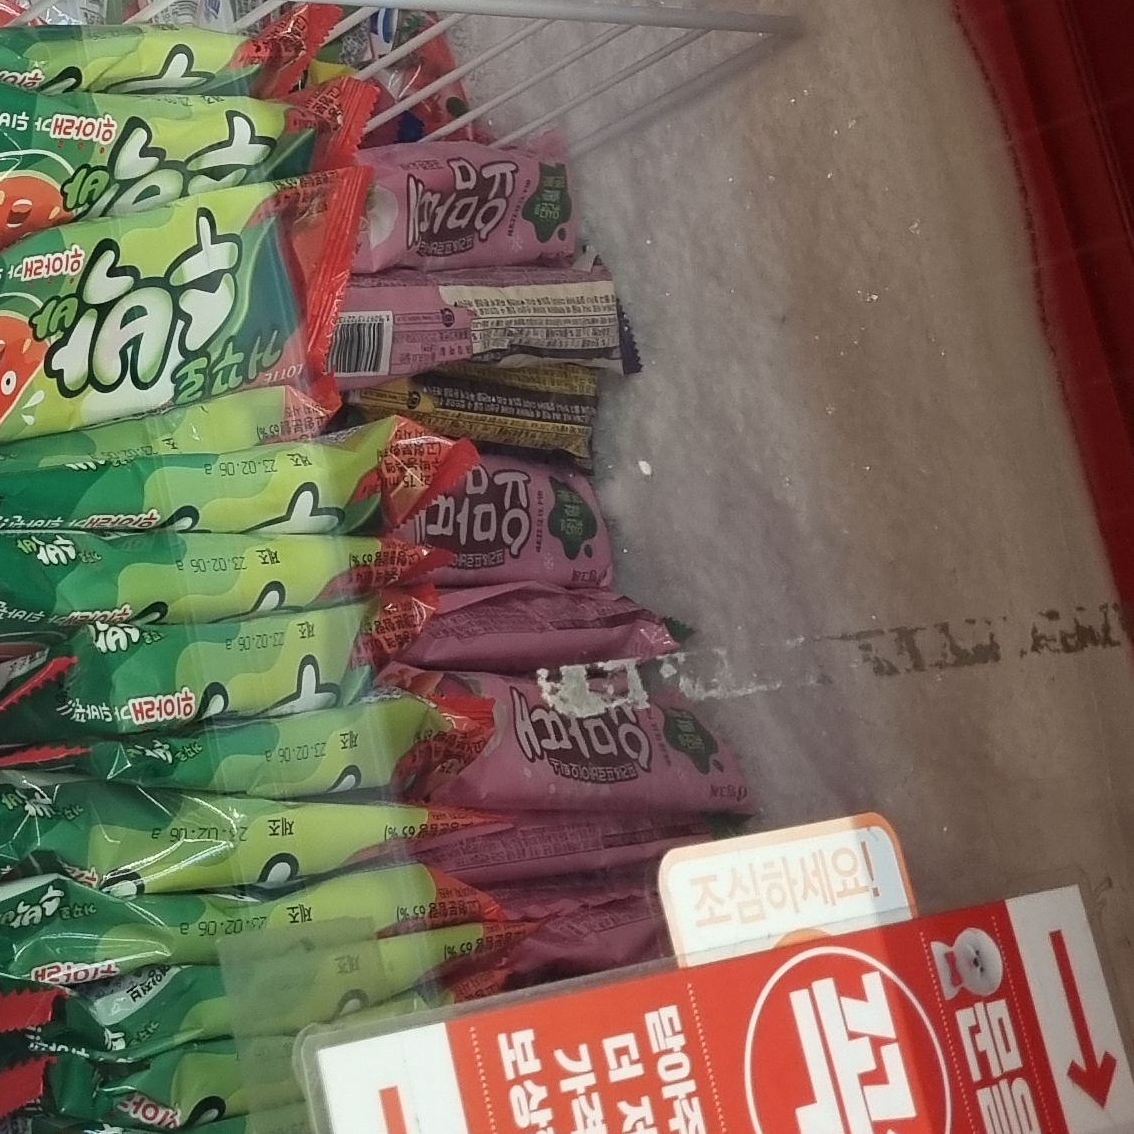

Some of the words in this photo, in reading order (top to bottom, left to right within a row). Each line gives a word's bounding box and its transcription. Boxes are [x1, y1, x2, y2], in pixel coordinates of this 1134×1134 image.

[33, 108, 118, 147] 위아래가
[5, 242, 85, 281] 위아래가
[19, 202, 253, 400] 수박바
[166, 328, 286, 401] 거꾸로
[261, 363, 304, 383] LOTTE
[217, 455, 277, 477] 23.02.06
[285, 450, 313, 469] 제조
[188, 553, 246, 575] 23.02.06
[254, 546, 280, 567] 제조
[235, 630, 285, 650] 23.02.06
[295, 620, 316, 640] 제조
[110, 685, 196, 726] 위아래가
[337, 730, 359, 750] 제조
[274, 740, 327, 763] 23.02.06
[265, 815, 296, 839] 제조
[401, 824, 416, 838] 65
[687, 840, 880, 931] 조심하세요!
[285, 902, 314, 924] 제조
[412, 904, 426, 919] 65
[458, 941, 473, 955] 65
[602, 1033, 644, 1082] 더
[497, 1029, 555, 1134] 보상
